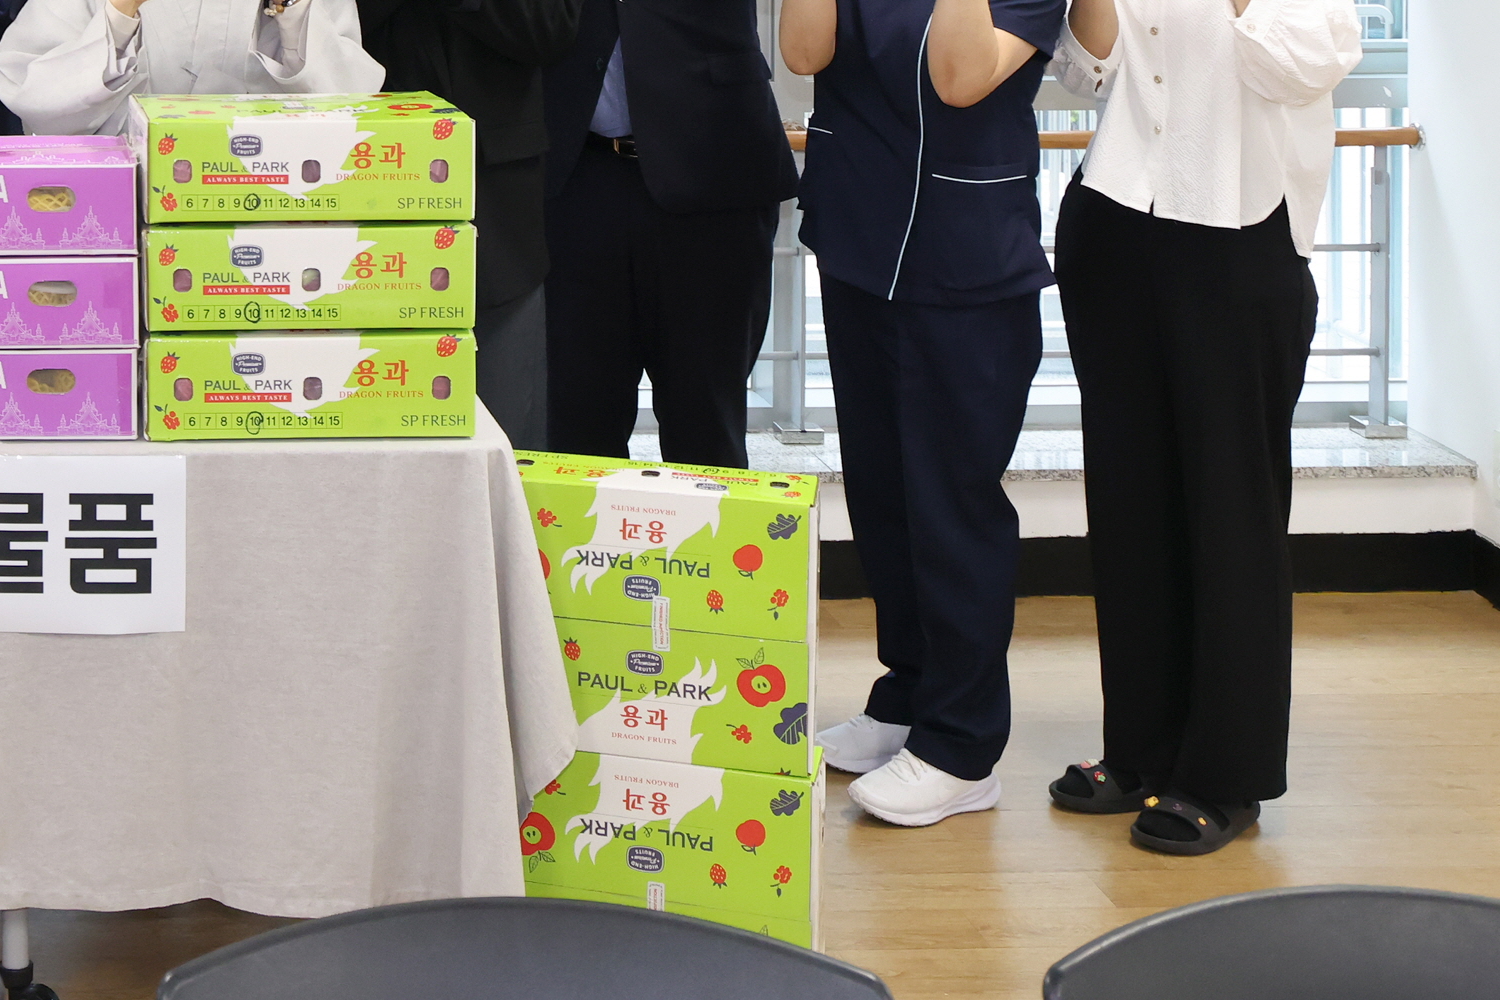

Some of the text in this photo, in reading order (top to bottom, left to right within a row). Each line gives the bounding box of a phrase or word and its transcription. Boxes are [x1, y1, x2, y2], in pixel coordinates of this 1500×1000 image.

[350, 142, 407, 169] 용과
[202, 161, 238, 173] PAUL
[252, 161, 290, 173] PARK
[336, 173, 421, 181] DRAGON FRUITS
[186, 198, 194, 208] 6
[202, 198, 209, 208] 7
[217, 198, 225, 208] 8
[233, 198, 241, 208] 9
[264, 198, 274, 208] 11
[279, 198, 290, 208] 12
[294, 198, 306, 208] 13
[310, 198, 321, 208] 14
[326, 198, 337, 208] 15
[397, 197, 462, 210] SP FRESH
[351, 251, 407, 279] 용과
[202, 272, 239, 283] PAUL
[253, 272, 291, 283] PARK
[337, 282, 422, 291] DRAGON FRUITS
[187, 308, 195, 319] 6
[203, 308, 210, 319] 7
[218, 308, 226, 319] 8
[234, 308, 242, 319] 9
[264, 308, 275, 319] 11
[280, 308, 291, 319] 12
[295, 308, 307, 319] 13
[311, 308, 323, 319] 14
[327, 308, 338, 319] 15
[398, 306, 464, 319] SP FRESH
[353, 359, 409, 387] 용과
[204, 380, 241, 391] PAUL
[254, 379, 293, 390] PARK
[386, 390, 424, 398] FRUITS
[188, 416, 196, 427] 6
[204, 416, 212, 427] 7
[220, 416, 228, 427] 8
[236, 416, 243, 427] 9
[266, 416, 276, 427] 11
[281, 416, 293, 427] 12
[297, 416, 308, 427] 13
[313, 416, 324, 427] 14
[328, 416, 340, 427] 15
[401, 414, 466, 427] SP FRESH
[610, 504, 676, 516] DRAGON FRUITS
[619, 518, 667, 544] 용과
[576, 549, 710, 578] PAUL & PARK
[577, 671, 712, 702] PAUL & PARK
[620, 704, 668, 731] 용과
[611, 731, 678, 746] DRAGON FRUITS
[613, 774, 680, 789] DRAGON FRUITS
[622, 788, 671, 816] 용과
[579, 817, 714, 852] PAUL & PARK
